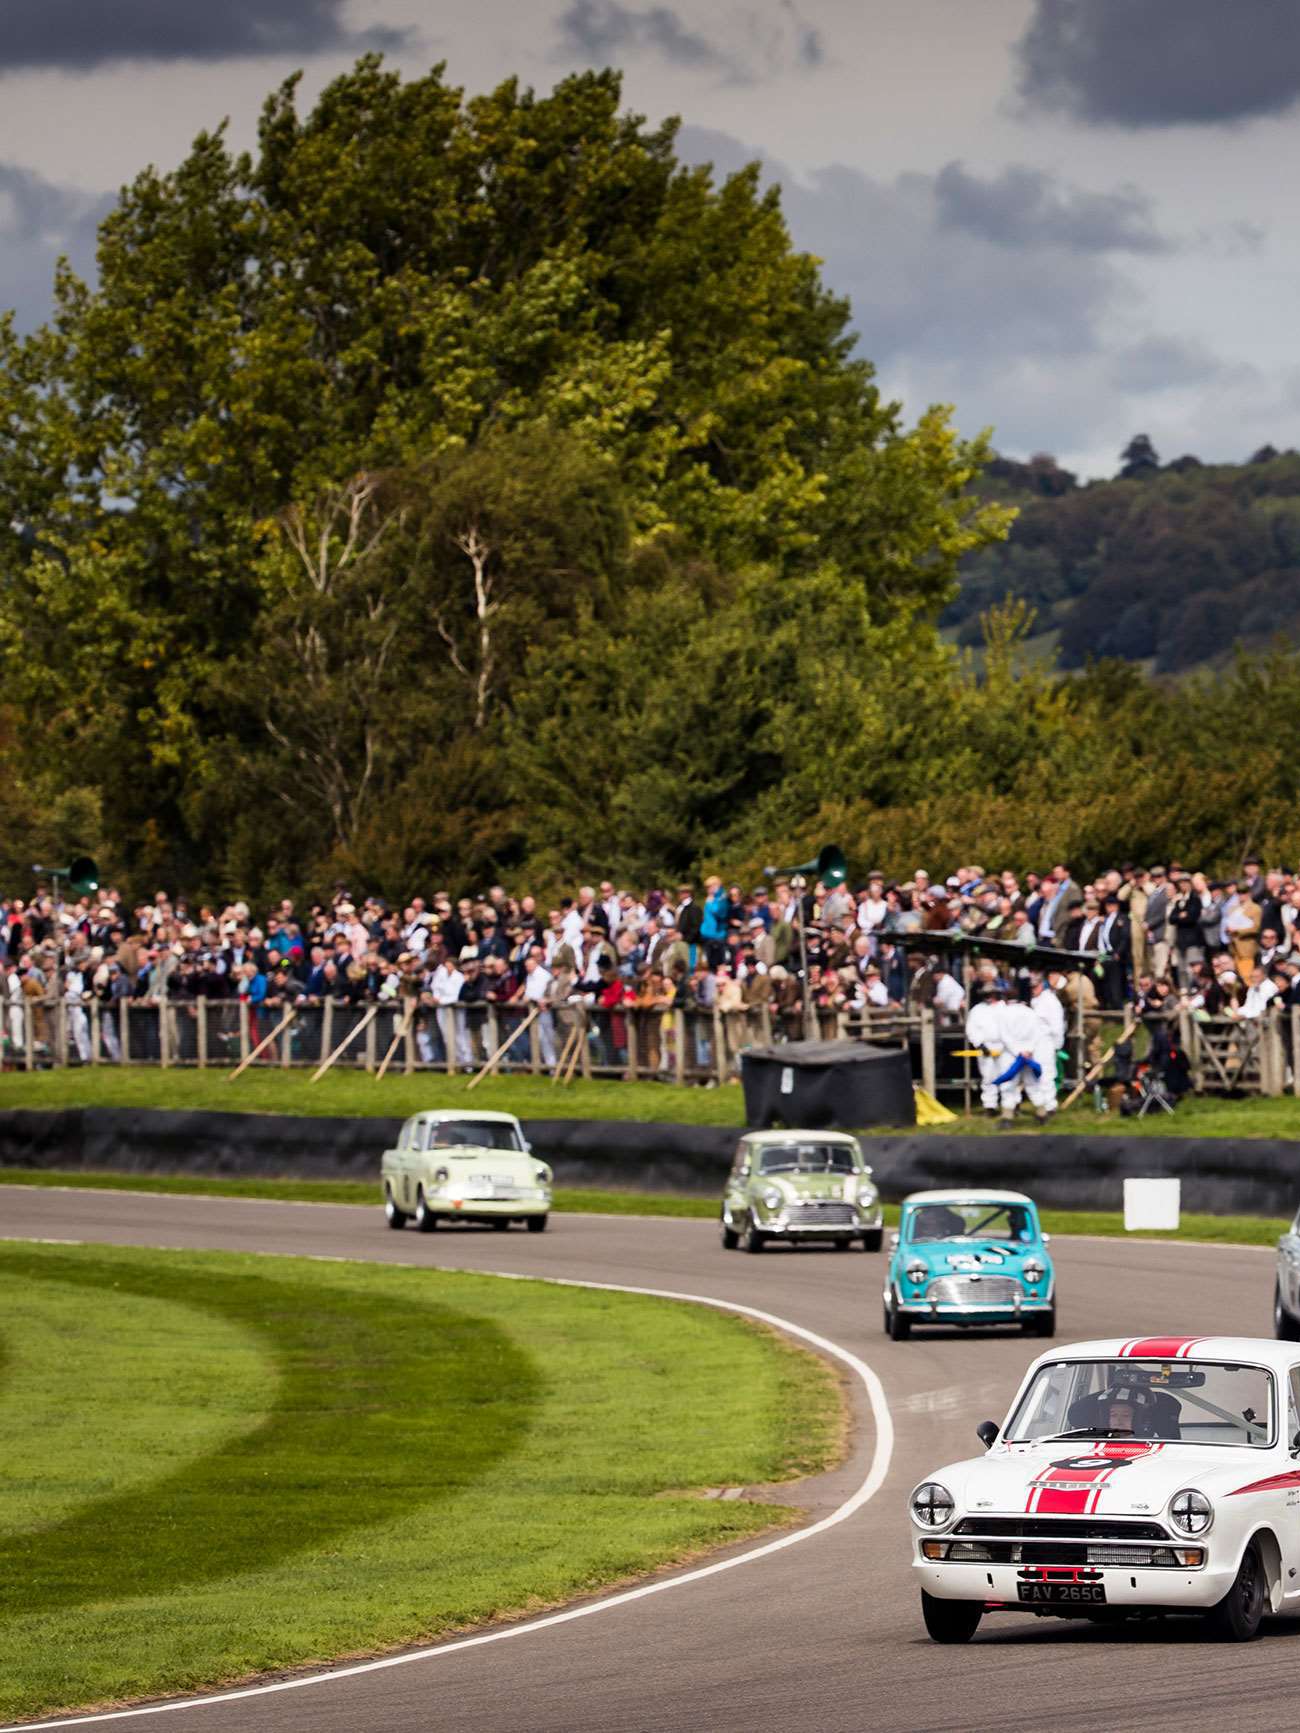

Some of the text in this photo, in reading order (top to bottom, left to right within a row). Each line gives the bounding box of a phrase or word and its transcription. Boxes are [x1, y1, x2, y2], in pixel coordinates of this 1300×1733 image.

[1068, 1458, 1113, 1468] 9
[1020, 1584, 1102, 1601] FAV 265C
